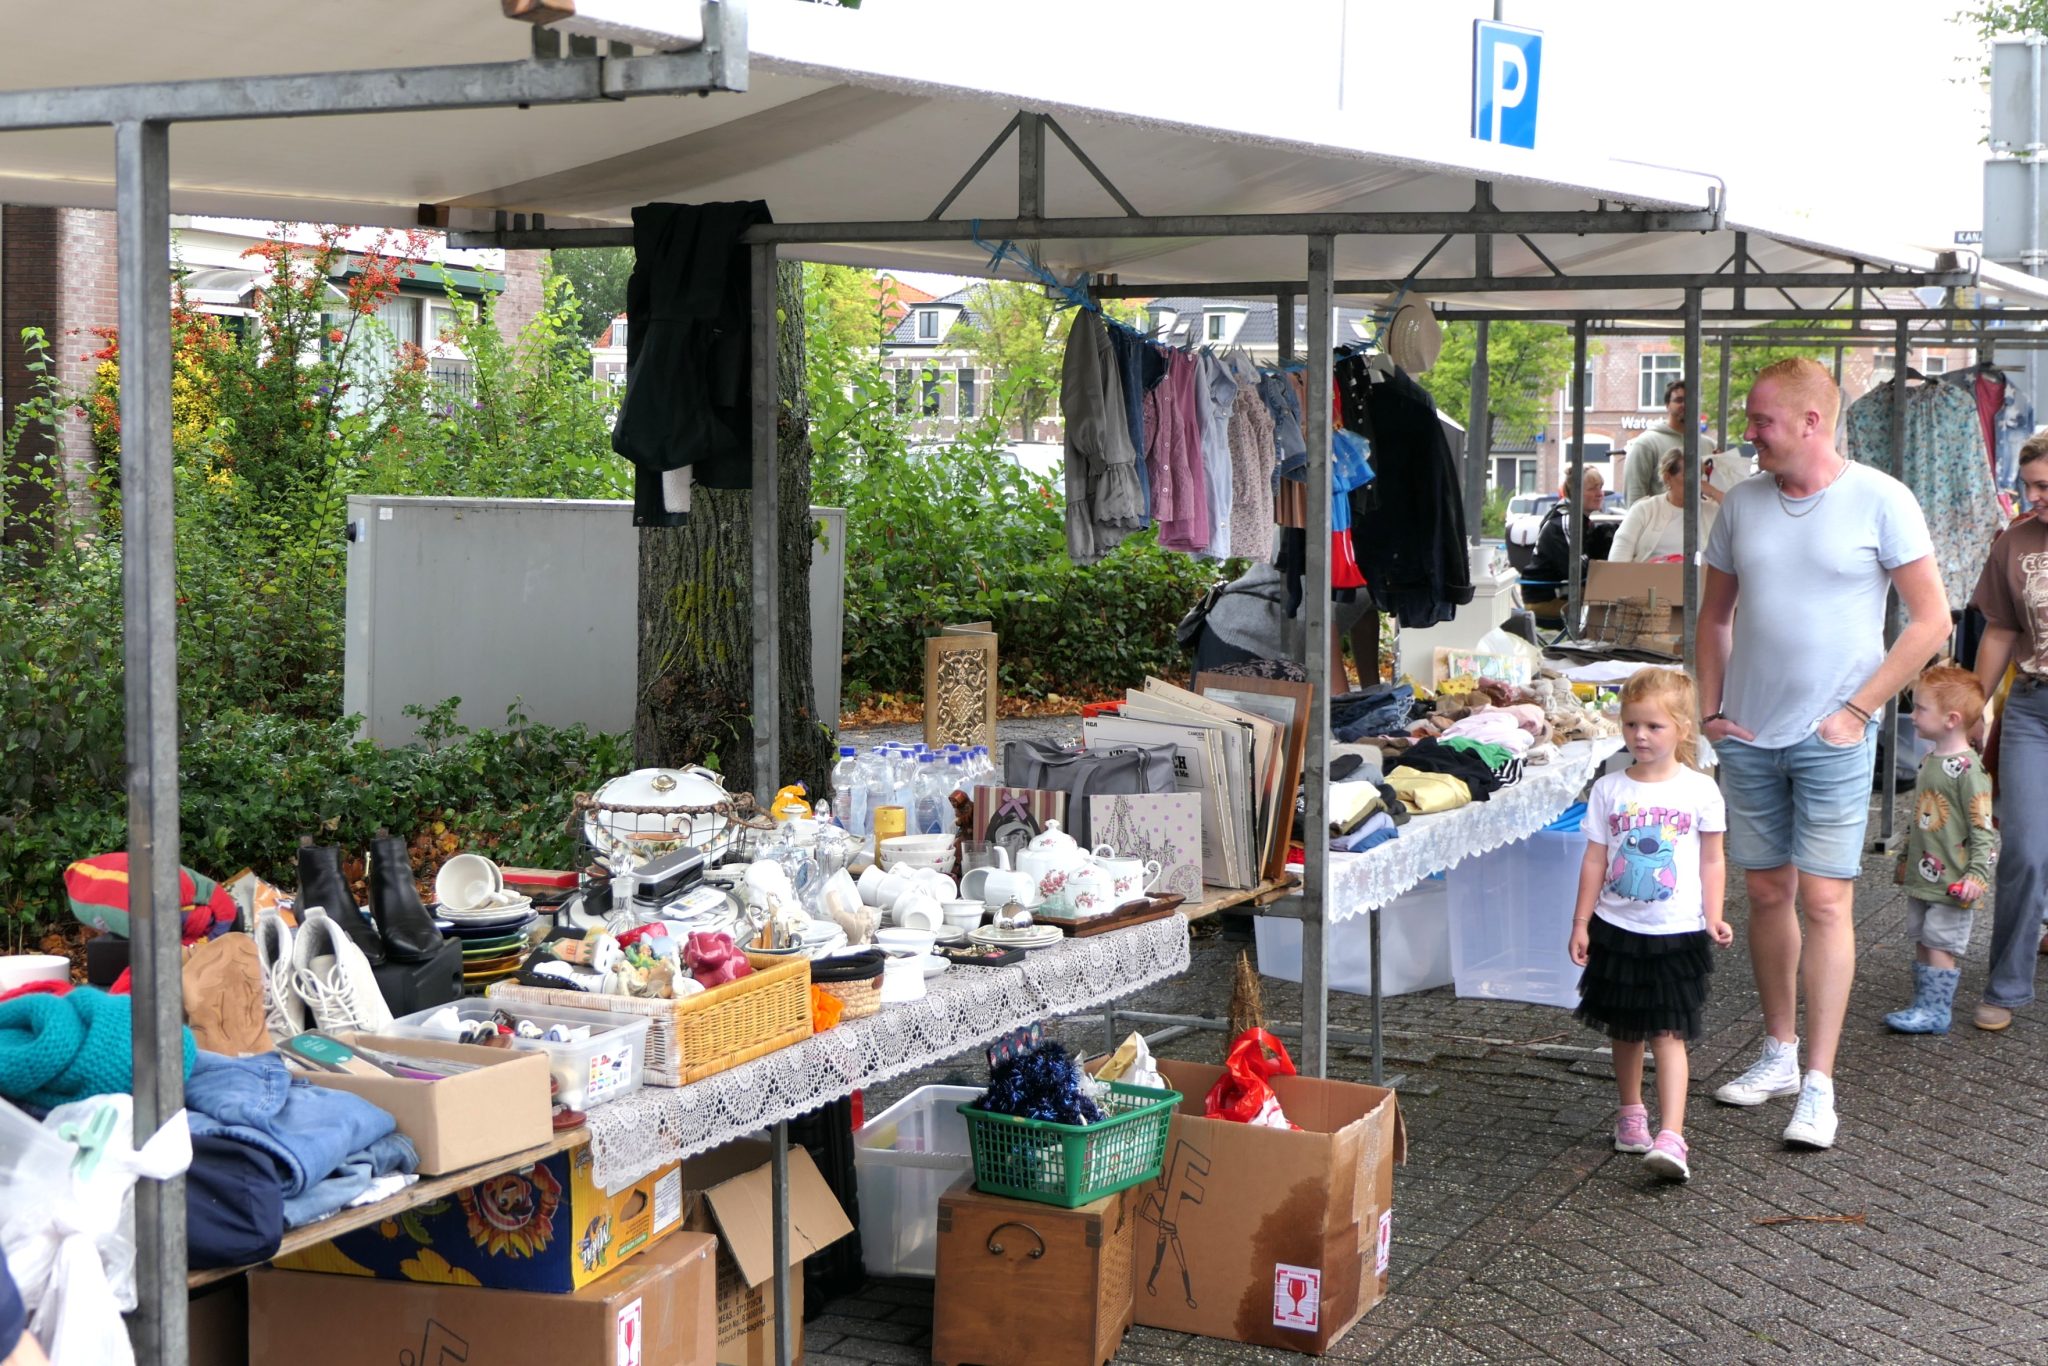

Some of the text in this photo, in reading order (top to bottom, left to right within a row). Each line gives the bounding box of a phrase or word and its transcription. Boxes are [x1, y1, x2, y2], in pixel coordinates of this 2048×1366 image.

[1491, 41, 1528, 143] P
[1957, 231, 1983, 242] KAN
[736, 1318, 766, 1336] Packaging
